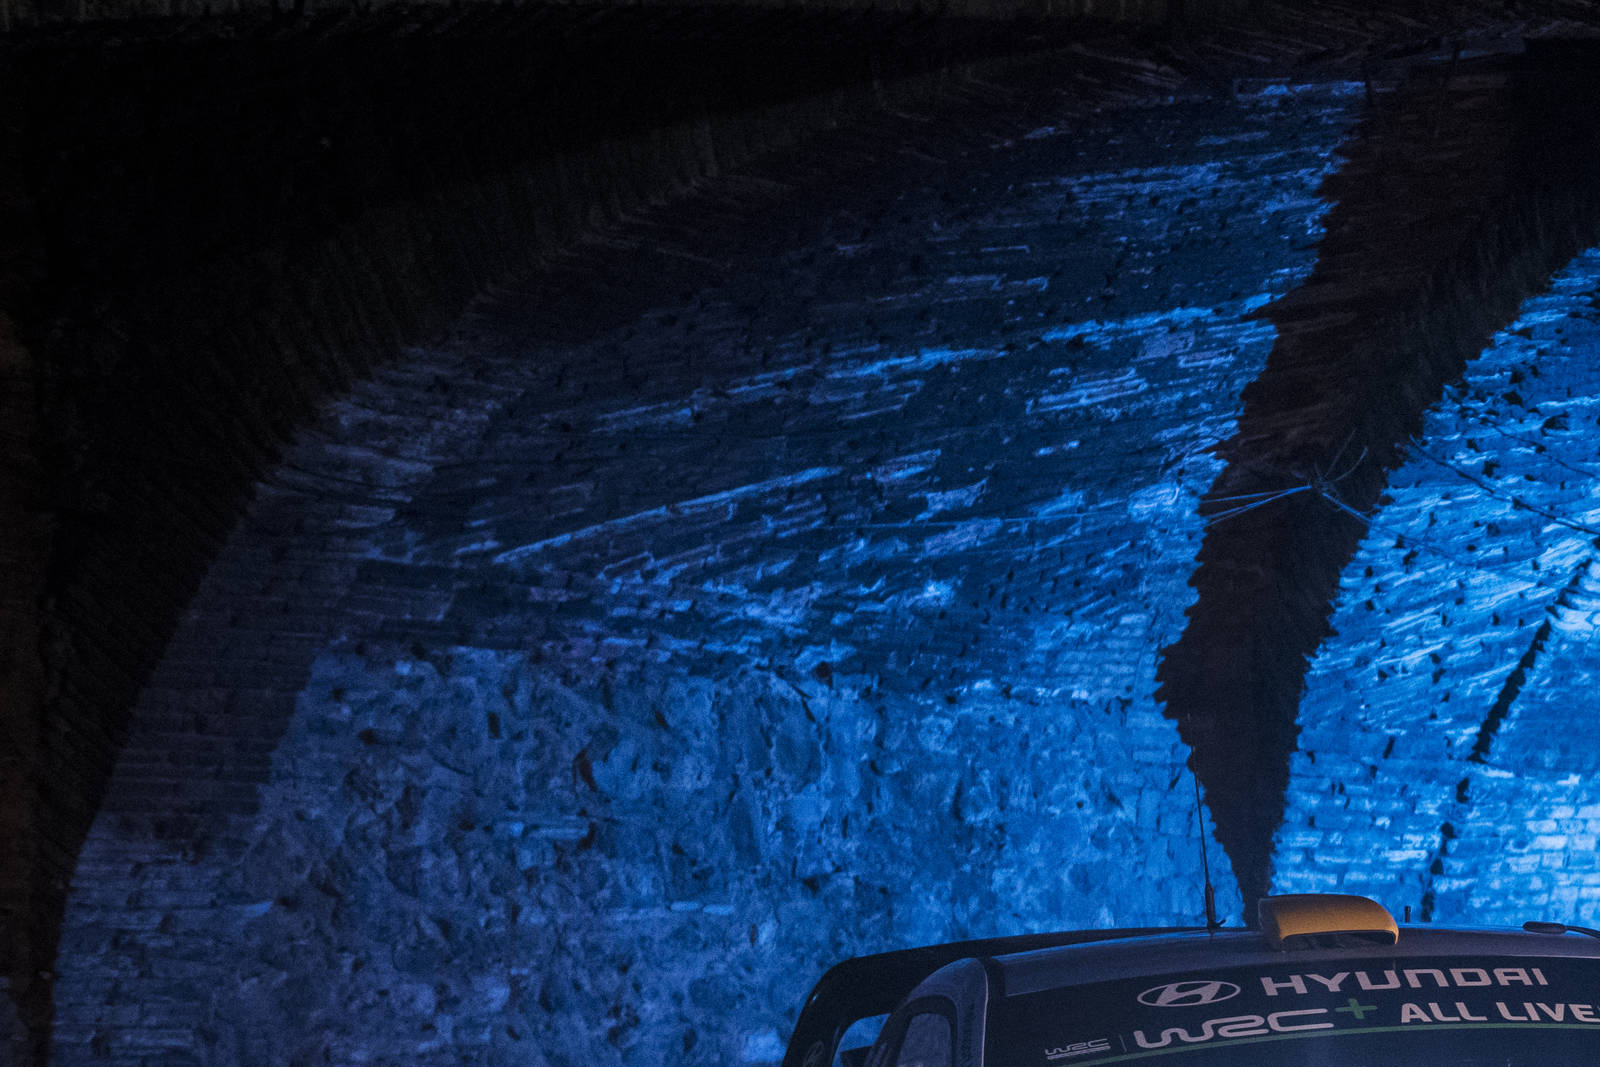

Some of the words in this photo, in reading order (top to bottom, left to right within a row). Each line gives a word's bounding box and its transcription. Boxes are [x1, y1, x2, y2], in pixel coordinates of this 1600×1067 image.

[1260, 967, 1549, 996] HYUNDAI
[1400, 1002, 1488, 1023] ALL
[1496, 1002, 1600, 1023] LIVE
